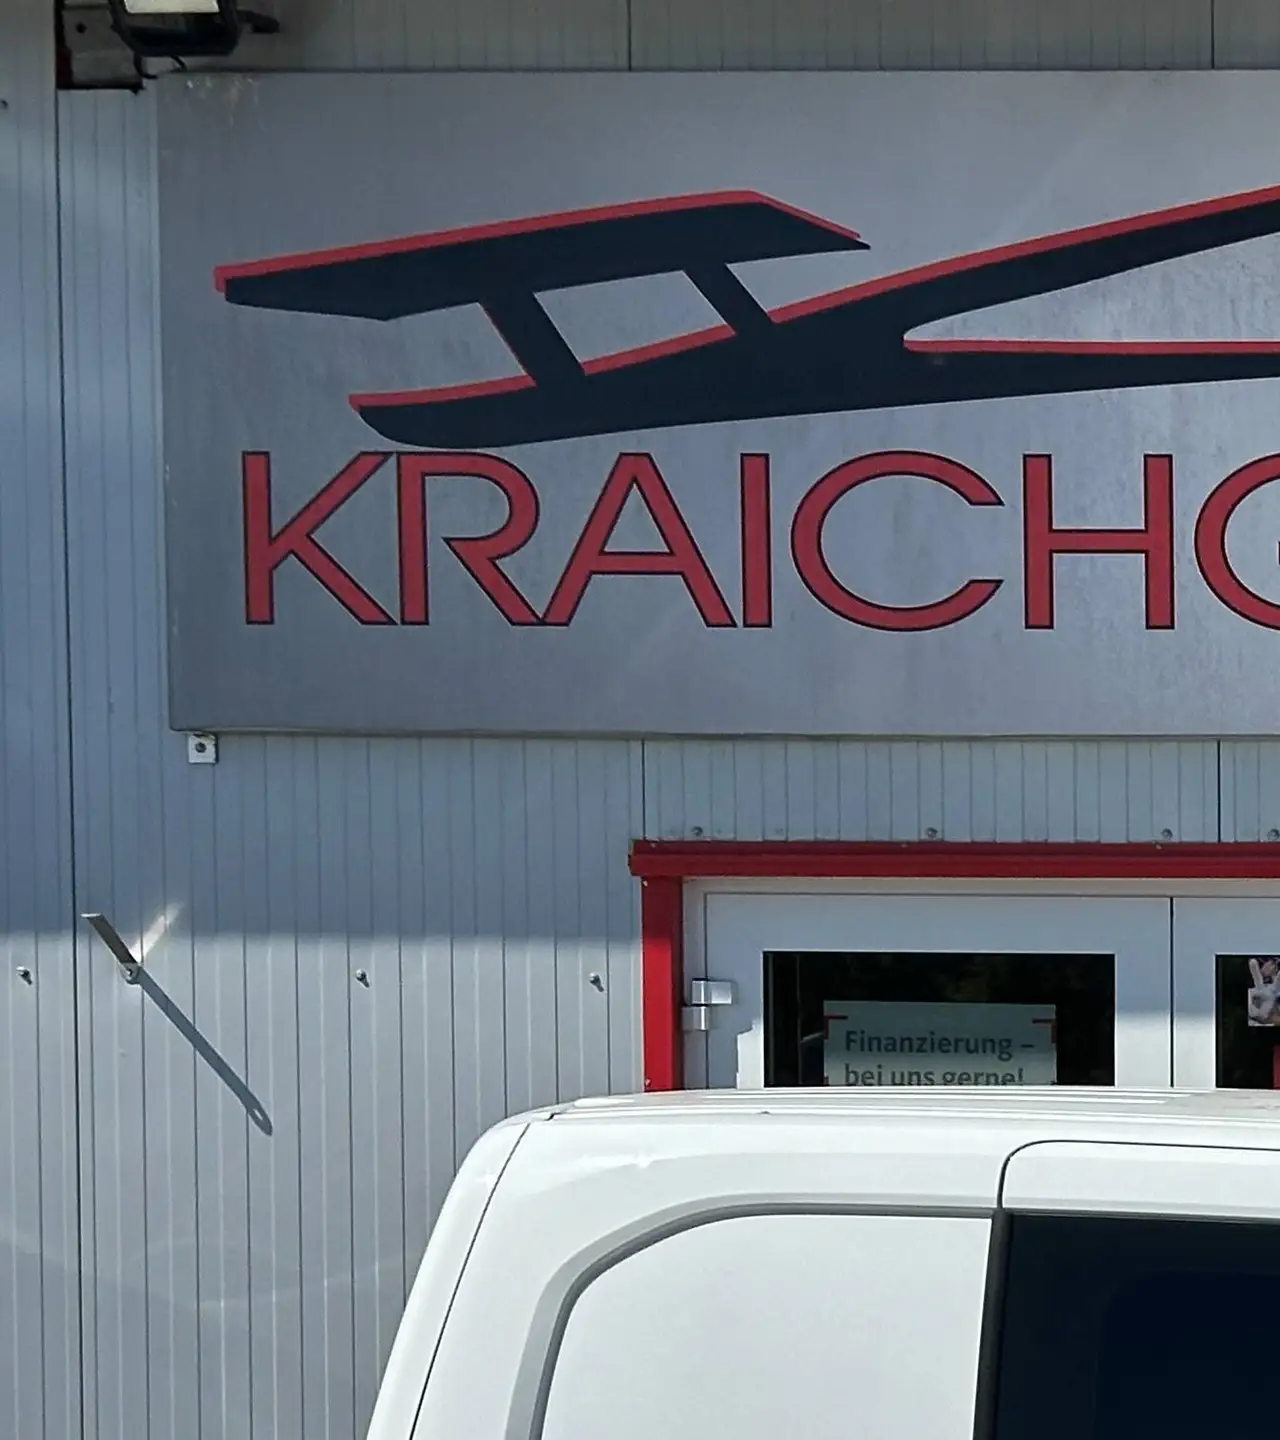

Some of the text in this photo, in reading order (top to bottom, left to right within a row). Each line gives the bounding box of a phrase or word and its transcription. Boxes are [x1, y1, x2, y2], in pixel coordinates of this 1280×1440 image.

[845, 1030, 1013, 1062] Finanzierung
[844, 1063, 883, 1086] bei
[891, 1069, 935, 1086] uns
